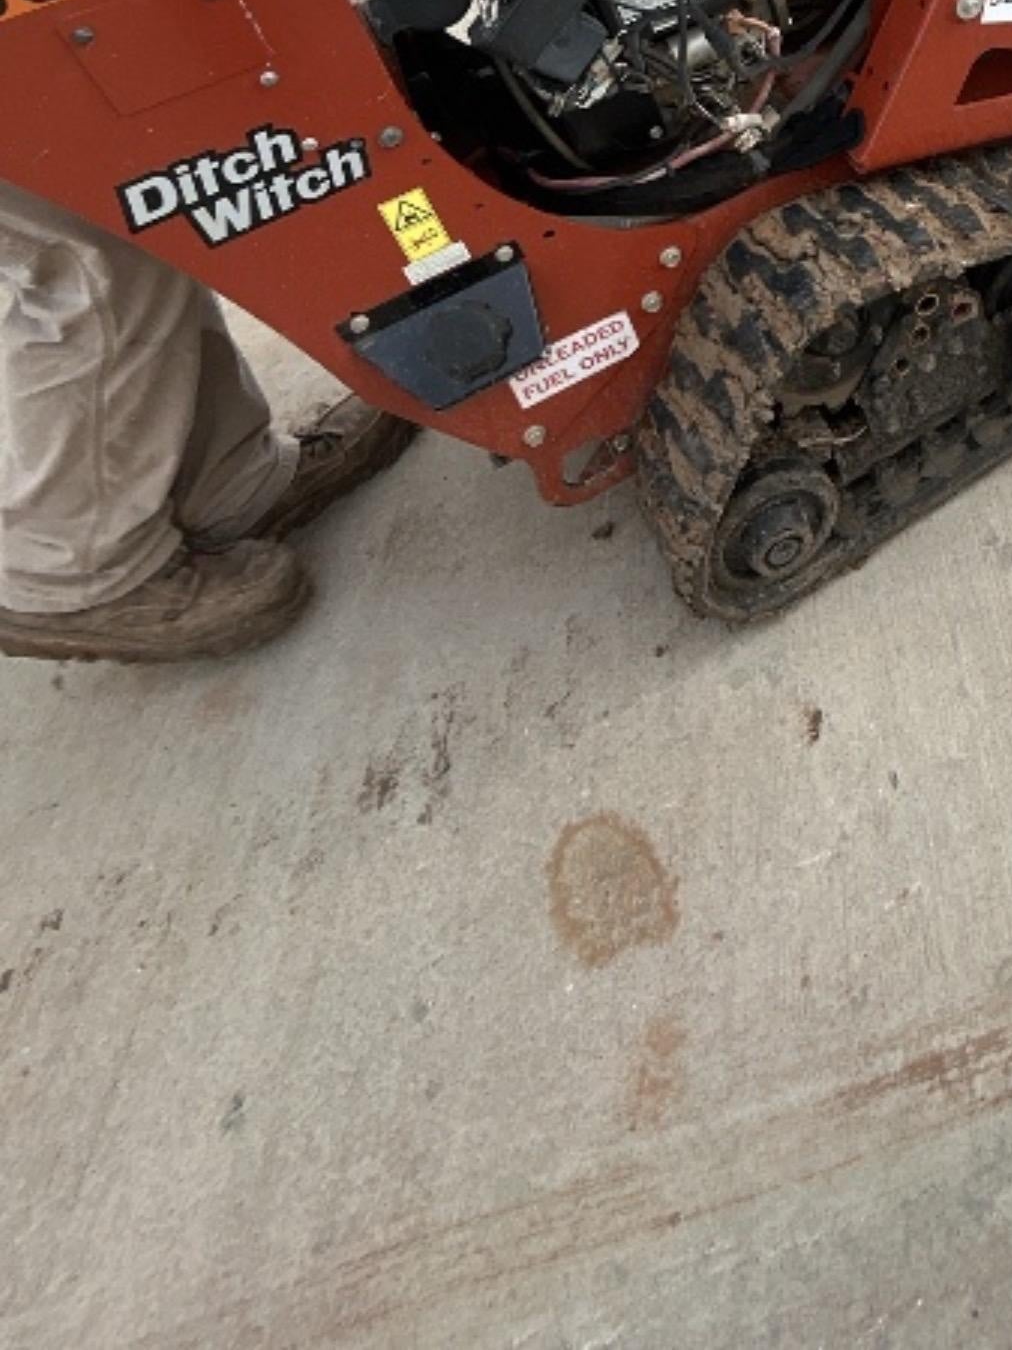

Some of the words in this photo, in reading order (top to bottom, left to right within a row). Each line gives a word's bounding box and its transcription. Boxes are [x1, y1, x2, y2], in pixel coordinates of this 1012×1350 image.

[124, 130, 297, 227] Ditch
[193, 147, 364, 243] Witch
[523, 368, 576, 399] FUEL
[580, 337, 629, 369] ONLY
